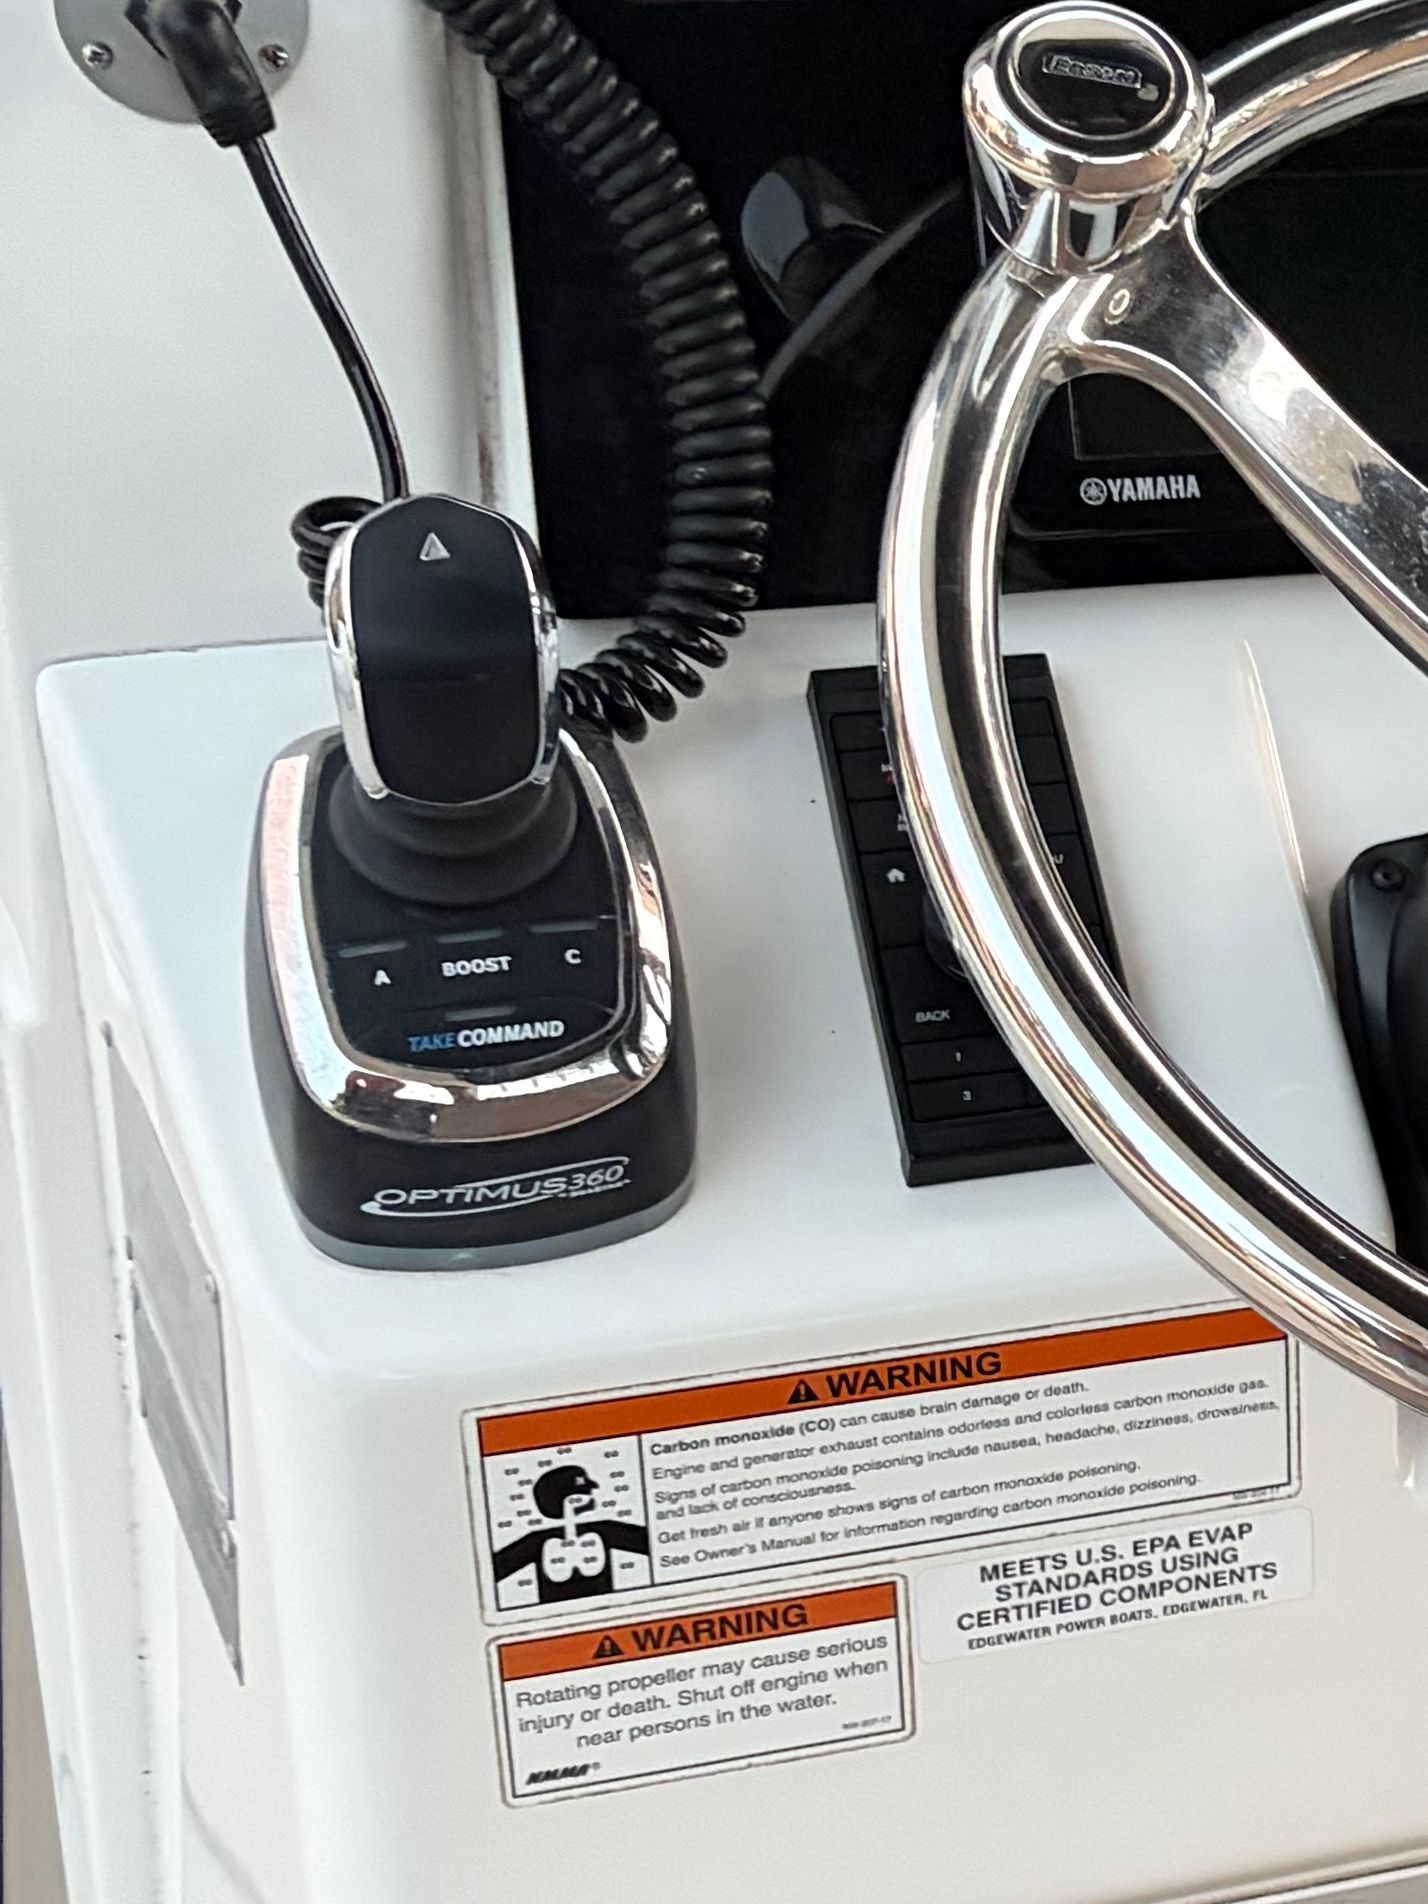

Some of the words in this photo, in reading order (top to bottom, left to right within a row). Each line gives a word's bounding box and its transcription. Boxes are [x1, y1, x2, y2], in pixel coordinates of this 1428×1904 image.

[1106, 474, 1201, 503] YAMAHA
[374, 970, 391, 986] A
[441, 955, 512, 977] BOOST
[564, 949, 582, 964] C
[915, 1009, 950, 1023] BACK
[374, 1163, 625, 1205] OPTIMUS360
[825, 1351, 1003, 1399] WARNING
[648, 1438, 711, 1457] Carbon
[714, 1424, 796, 1447] monoxide
[798, 1417, 837, 1437] (CO)
[838, 1415, 868, 1429] can
[870, 1407, 916, 1424] cause
[919, 1400, 958, 1417] brain
[960, 1392, 1021, 1410] damage
[1024, 1388, 1040, 1401] or
[651, 1463, 706, 1481] Engine
[709, 1455, 740, 1472] and
[742, 1446, 816, 1470] generator
[818, 1436, 879, 1456] exhaust
[881, 1427, 945, 1446] contains
[947, 1417, 1011, 1436] odorless
[1014, 1410, 1043, 1426] and
[1045, 1402, 1110, 1421] colorless
[1113, 1394, 1163, 1411] carbon
[1166, 1383, 1235, 1403] monoxide
[654, 1488, 698, 1505] Signs
[700, 1482, 717, 1497] of
[719, 1477, 772, 1495] carbon
[775, 1464, 849, 1485] monoxide
[851, 1454, 924, 1477] poisoning
[926, 1444, 980, 1462] include
[655, 1505, 686, 1521] and
[687, 1500, 720, 1516] lack
[722, 1496, 739, 1511] of
[656, 1530, 686, 1545] Get
[689, 1523, 728, 1540] fresh
[731, 1519, 751, 1533] air
[754, 1516, 765, 1529] if
[767, 1510, 824, 1528] anyone
[827, 1501, 875, 1519] shows
[878, 1495, 919, 1512] signs
[920, 1489, 937, 1504] of
[939, 1483, 991, 1501] carbon
[993, 1471, 1065, 1492] monoxide
[659, 1554, 691, 1569] See
[693, 1543, 758, 1563] Owner's
[760, 1532, 817, 1552] Manual
[819, 1530, 840, 1543] for
[843, 1517, 927, 1539] information
[929, 1505, 999, 1526] regarding
[1002, 1496, 1053, 1514] carbon
[1055, 1484, 1126, 1505] monoxide
[979, 1552, 1069, 1584] MEETS
[1075, 1543, 1125, 1567] U.S.
[1132, 1533, 1182, 1558] EPA
[1187, 1522, 1253, 1549] EVAP
[994, 1560, 1154, 1603] STANDARDS
[1160, 1546, 1239, 1575] USING
[956, 1592, 1093, 1632] CERTIFIED
[1098, 1561, 1278, 1608] COMPONENTS
[967, 1625, 1052, 1651] EDGEWATER
[1055, 1616, 1106, 1636] POWER
[1252, 1588, 1269, 1602] FL
[631, 1603, 808, 1652] WARNING
[515, 1683, 602, 1709] Rotating
[607, 1667, 697, 1698] propeller
[701, 1658, 745, 1678] may
[749, 1648, 811, 1670] cause
[815, 1635, 889, 1659] serious
[518, 1712, 575, 1735] injury
[579, 1707, 603, 1723] or
[606, 1694, 672, 1719] death.
[677, 1685, 726, 1707] Shut
[729, 1678, 756, 1698] off
[760, 1669, 829, 1693] engine
[833, 1659, 889, 1680] when
[576, 1728, 624, 1749] near
[628, 1714, 712, 1743] persons
[715, 1708, 735, 1725] in
[739, 1703, 773, 1721] the
[776, 1693, 837, 1713] water.
